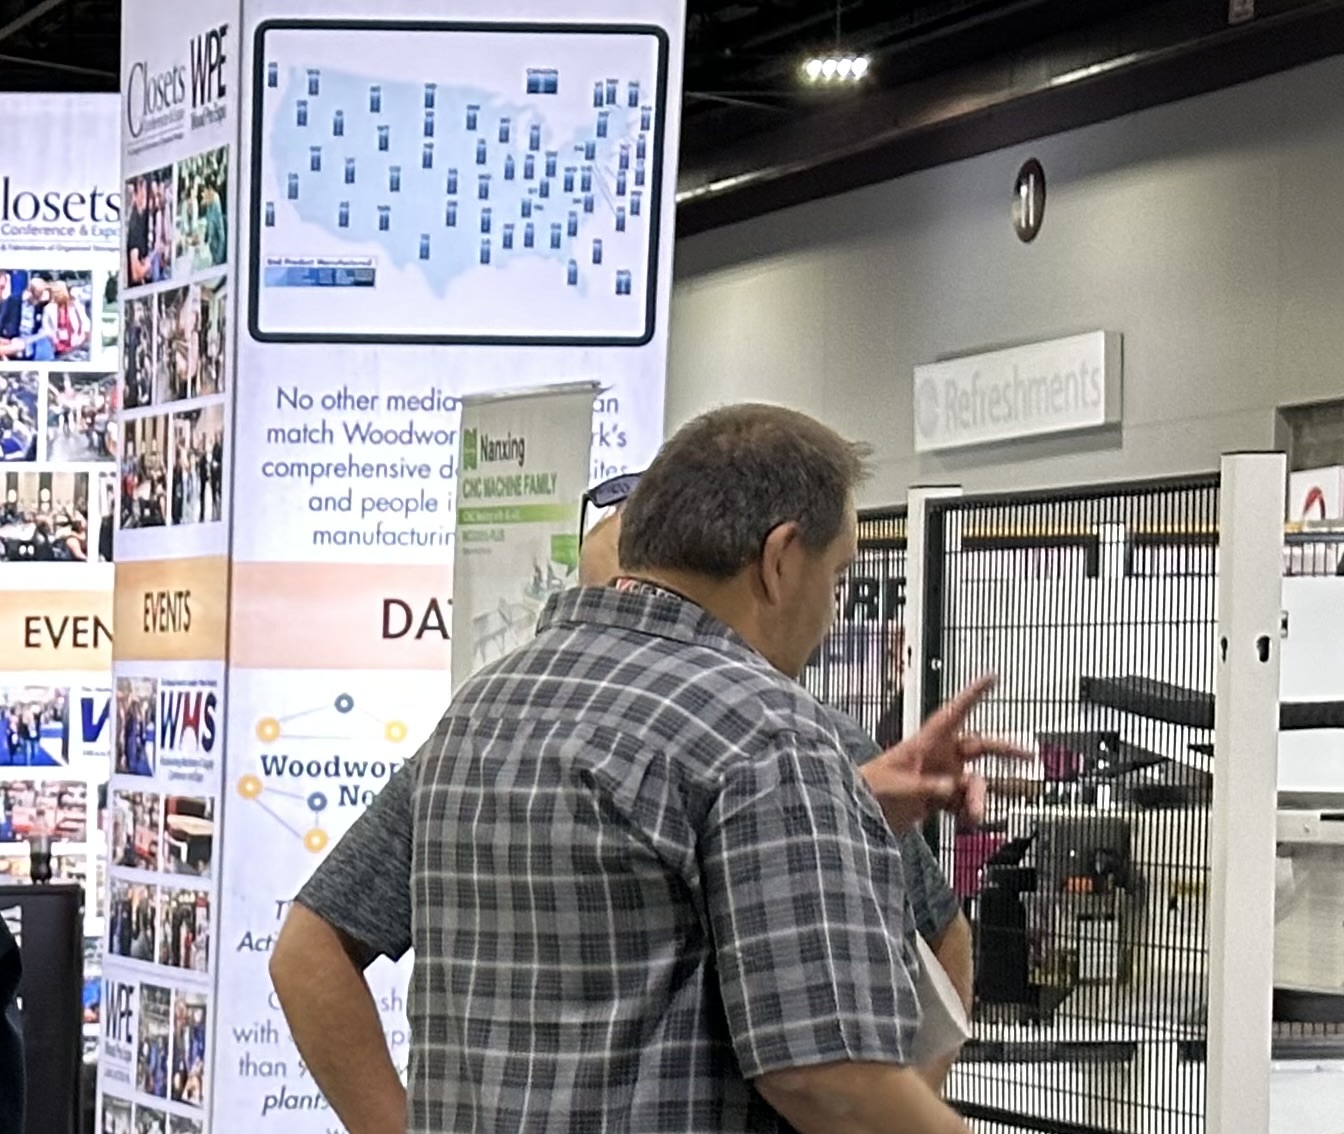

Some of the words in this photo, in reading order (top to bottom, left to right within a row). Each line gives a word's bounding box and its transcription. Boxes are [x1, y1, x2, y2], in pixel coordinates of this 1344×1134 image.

[190, 24, 228, 109] WPE
[1, 223, 75, 237] Conference
[277, 385, 313, 411] No
[321, 384, 379, 411] other
[387, 386, 457, 412] media
[944, 360, 1102, 432] Refreshments
[267, 418, 334, 445] match
[480, 431, 525, 468] Nanxing
[262, 453, 431, 486] comprehensive
[439, 454, 459, 479] d
[308, 487, 352, 512] and
[361, 488, 439, 519] people
[144, 590, 191, 634] EVENTS
[382, 597, 453, 640] DA
[236, 931, 278, 952] Act
[232, 1018, 279, 1044] with
[239, 1052, 287, 1077] than
